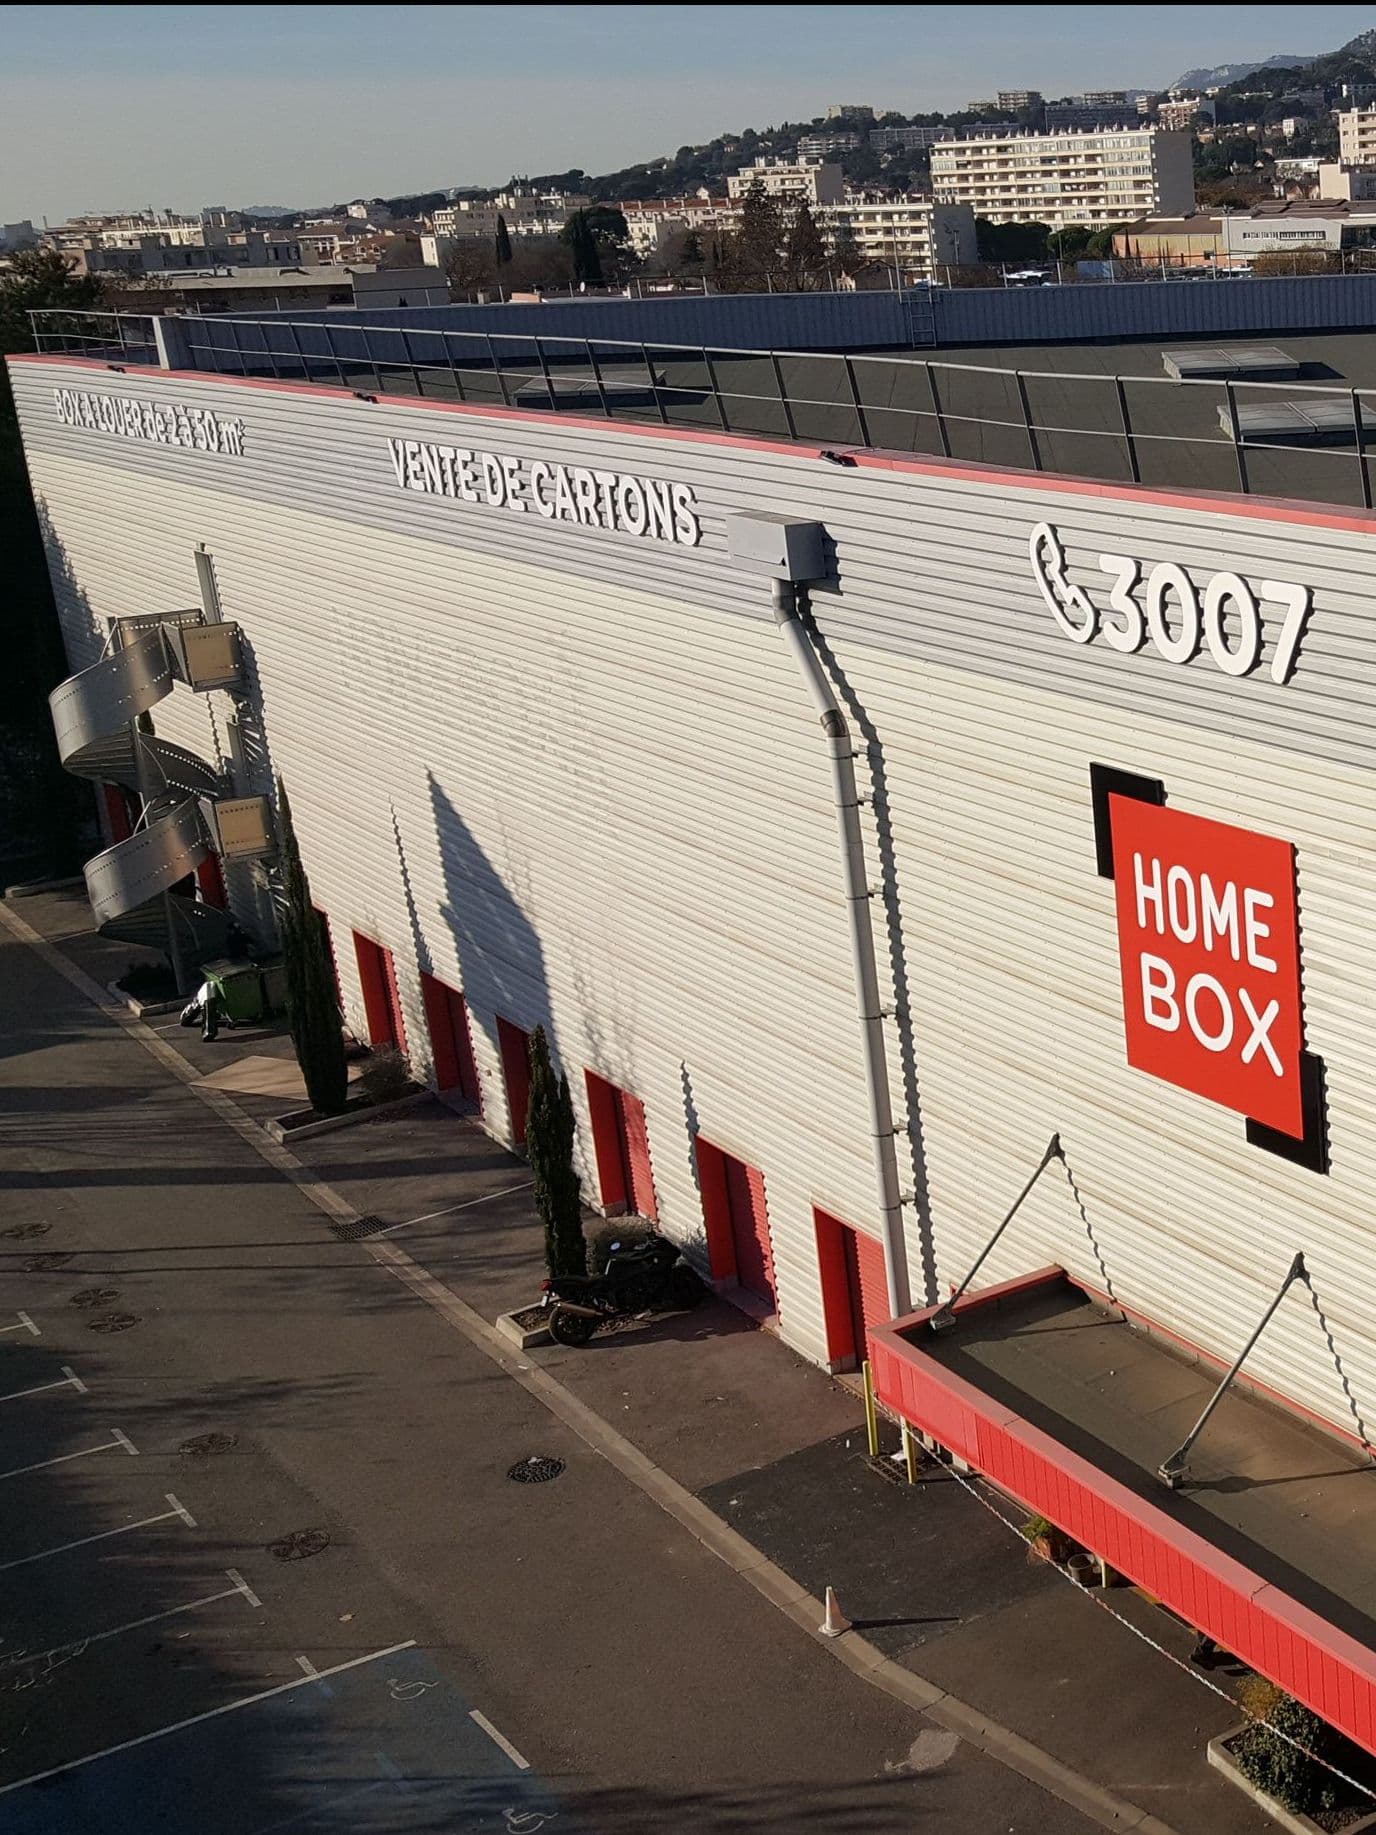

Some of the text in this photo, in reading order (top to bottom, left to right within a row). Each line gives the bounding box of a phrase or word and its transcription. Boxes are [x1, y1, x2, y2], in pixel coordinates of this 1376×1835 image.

[53, 388, 83, 427] BOX
[94, 395, 144, 438] LOUER
[145, 403, 166, 442] de
[195, 410, 219, 452] 50
[387, 438, 700, 546] VENTE DE CARTONS
[1100, 554, 1308, 684] 3007
[1133, 853, 1277, 973] HOME
[1140, 952, 1283, 1077] BOX
